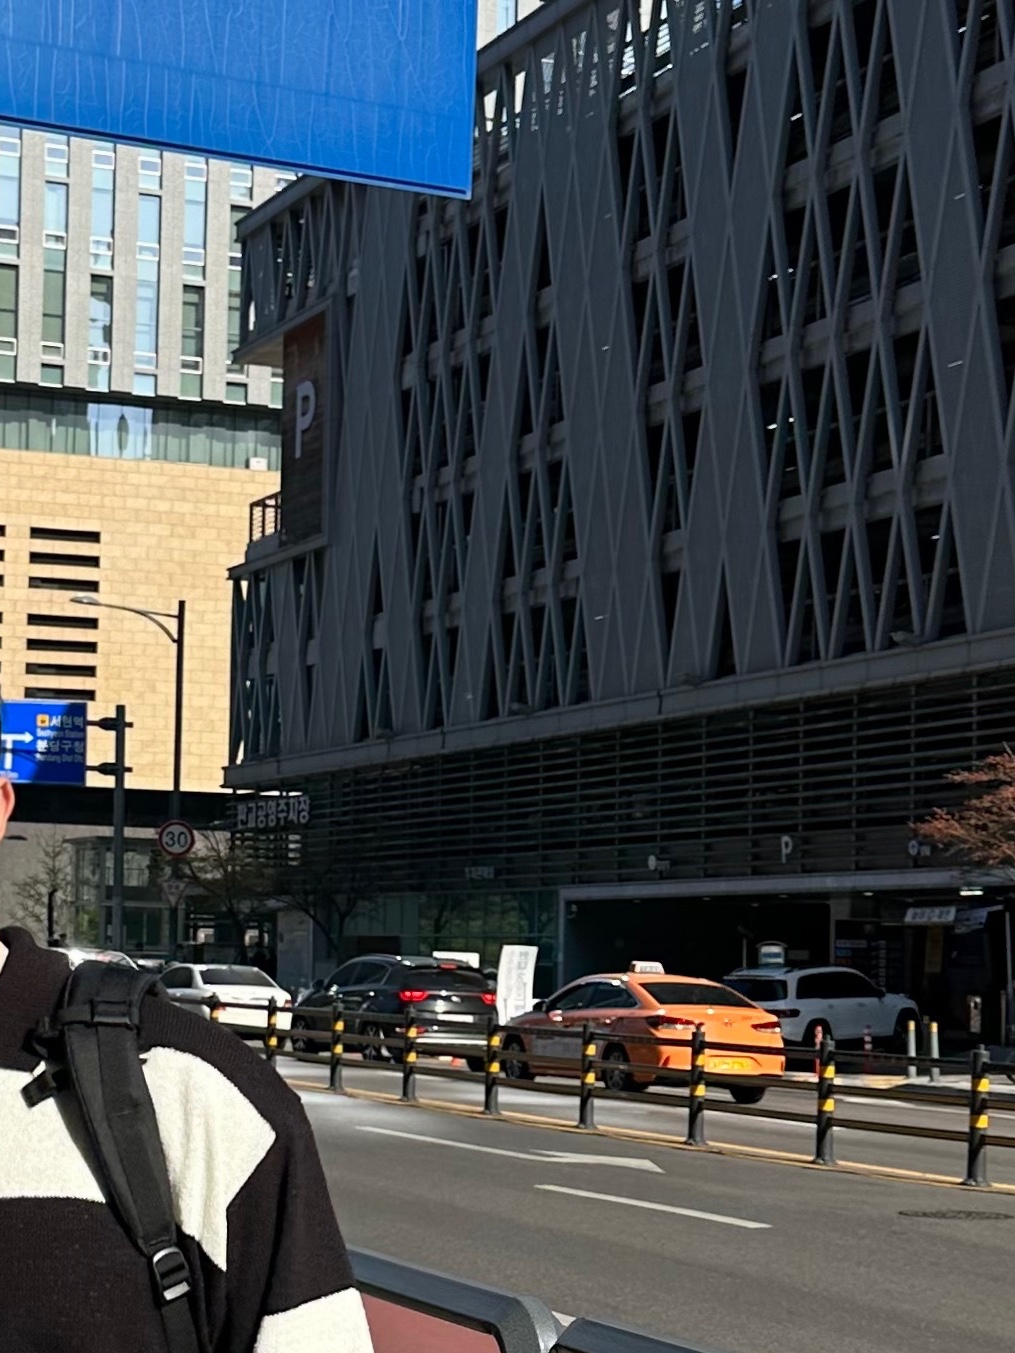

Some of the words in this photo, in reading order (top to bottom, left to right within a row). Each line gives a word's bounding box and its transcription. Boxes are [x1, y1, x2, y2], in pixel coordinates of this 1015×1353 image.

[295, 380, 316, 459] P
[50, 714, 84, 728] 서현역
[237, 796, 309, 829] 판교공영주차장
[165, 831, 188, 848] 30
[780, 835, 793, 863] P
